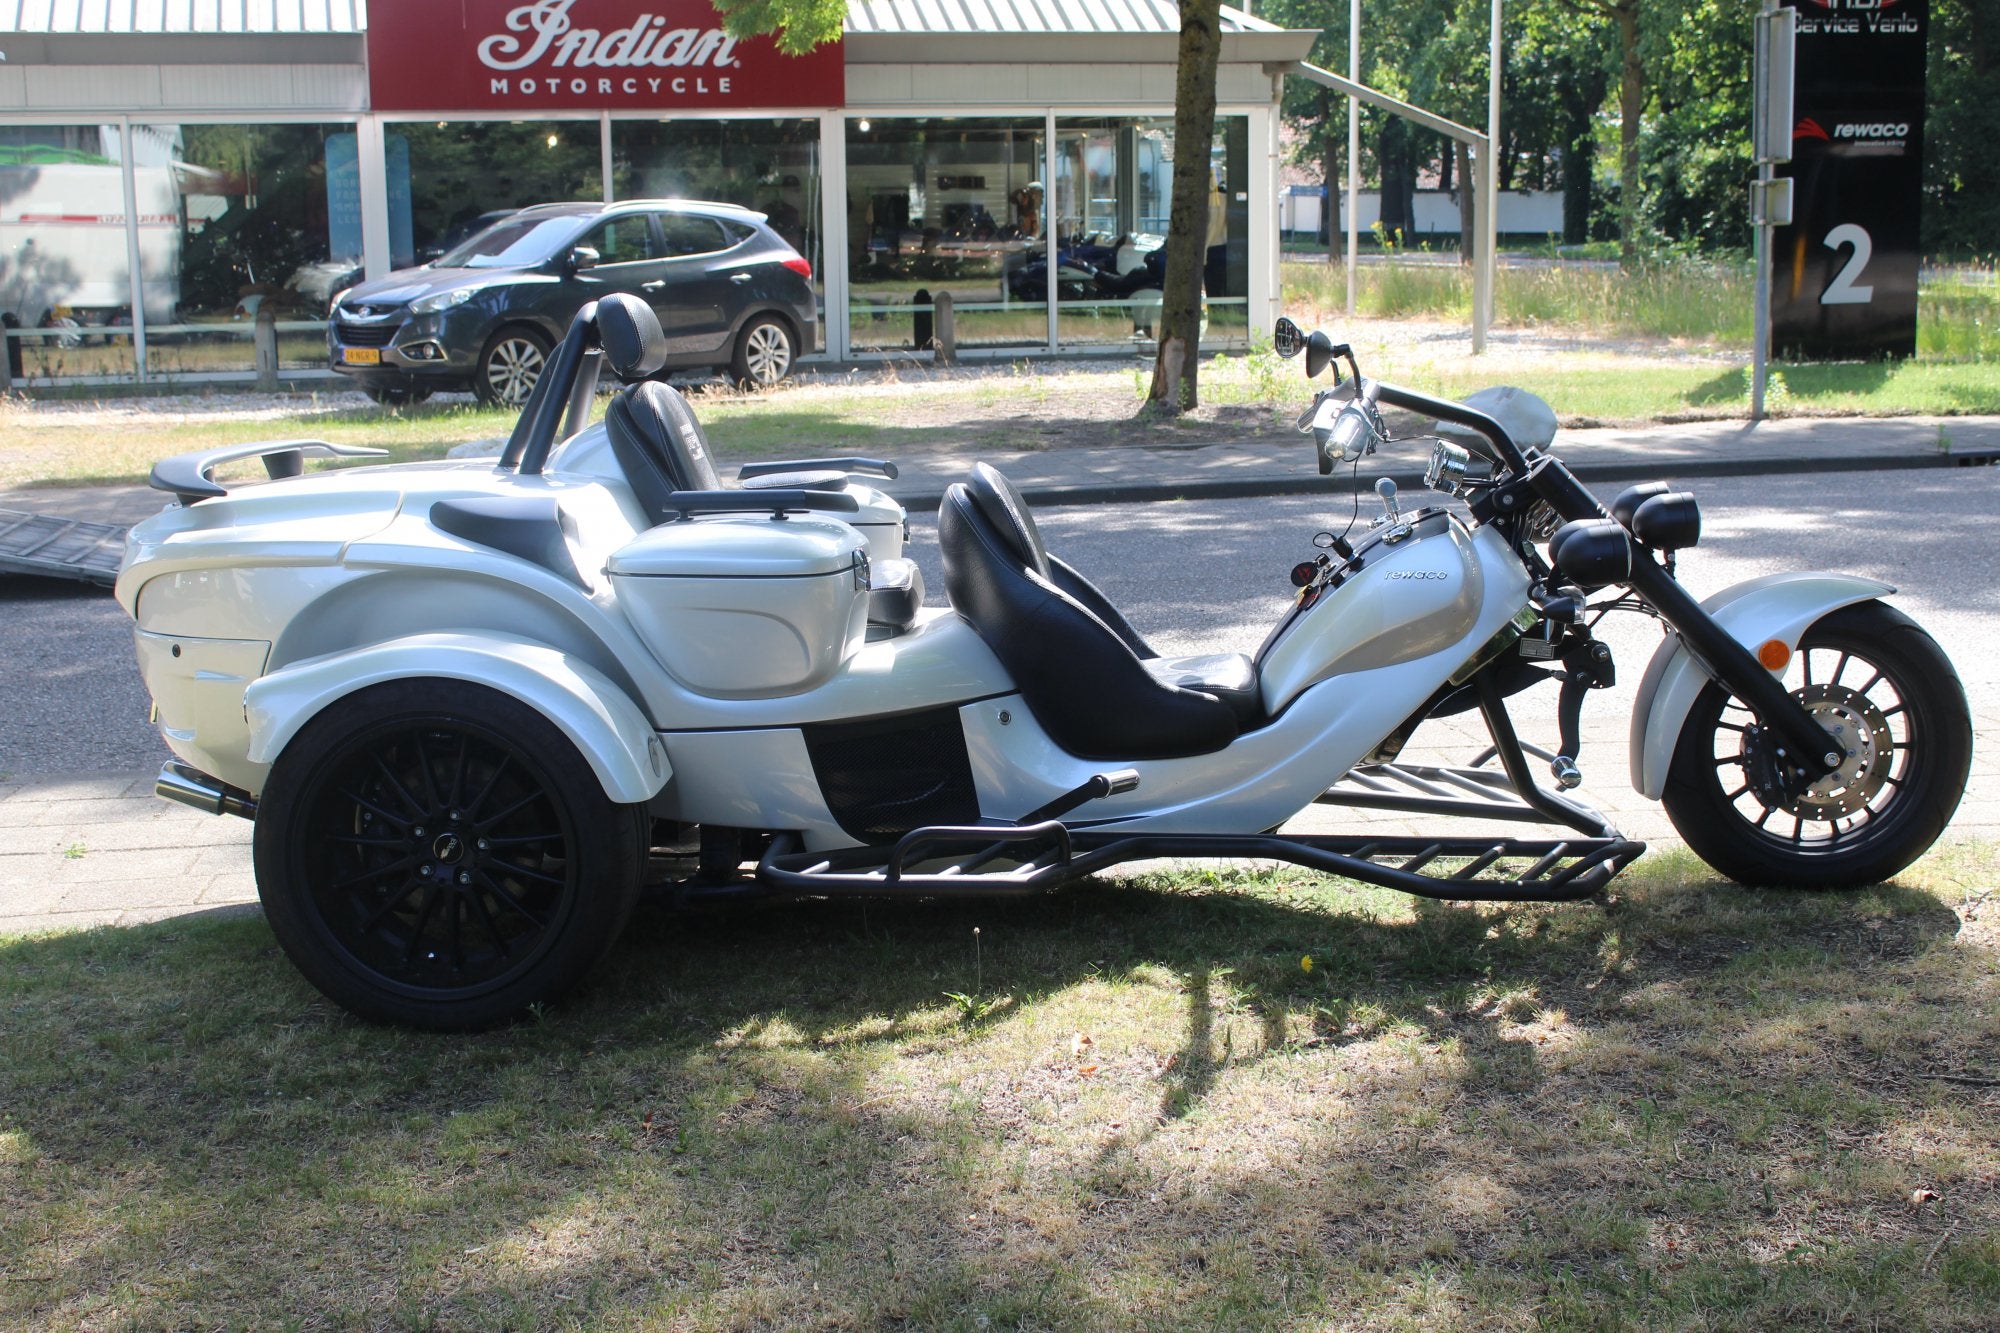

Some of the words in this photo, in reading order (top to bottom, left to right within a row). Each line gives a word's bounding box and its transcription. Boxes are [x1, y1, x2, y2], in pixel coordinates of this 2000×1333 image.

[1866, 12, 1918, 33] Venlo
[477, 0, 738, 70] Indian
[491, 78, 731, 94] MOTORCYCLE
[1834, 123, 1909, 138] rewaco
[1821, 223, 1873, 304] 2
[1384, 570, 1448, 580] rewaco
